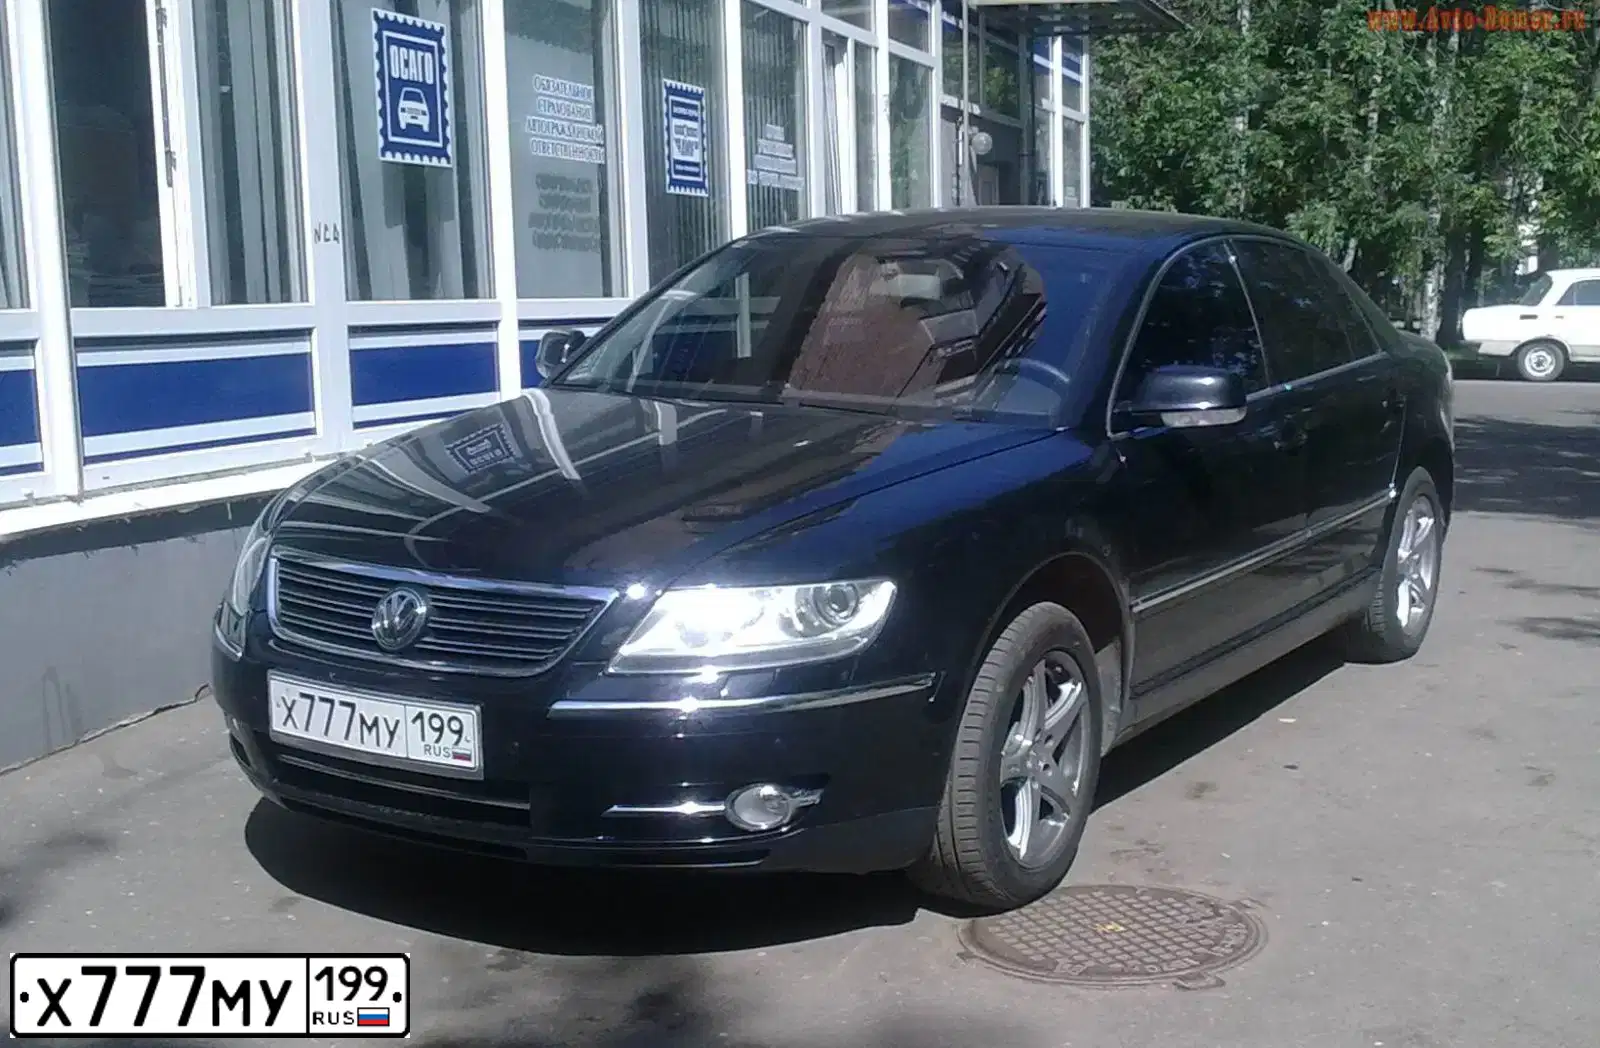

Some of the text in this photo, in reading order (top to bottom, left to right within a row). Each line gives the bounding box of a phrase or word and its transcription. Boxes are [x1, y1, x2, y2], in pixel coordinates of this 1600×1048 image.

[389, 45, 434, 85] ОСАГО
[281, 692, 464, 748] Х777МУ 199
[424, 743, 451, 759] RUS
